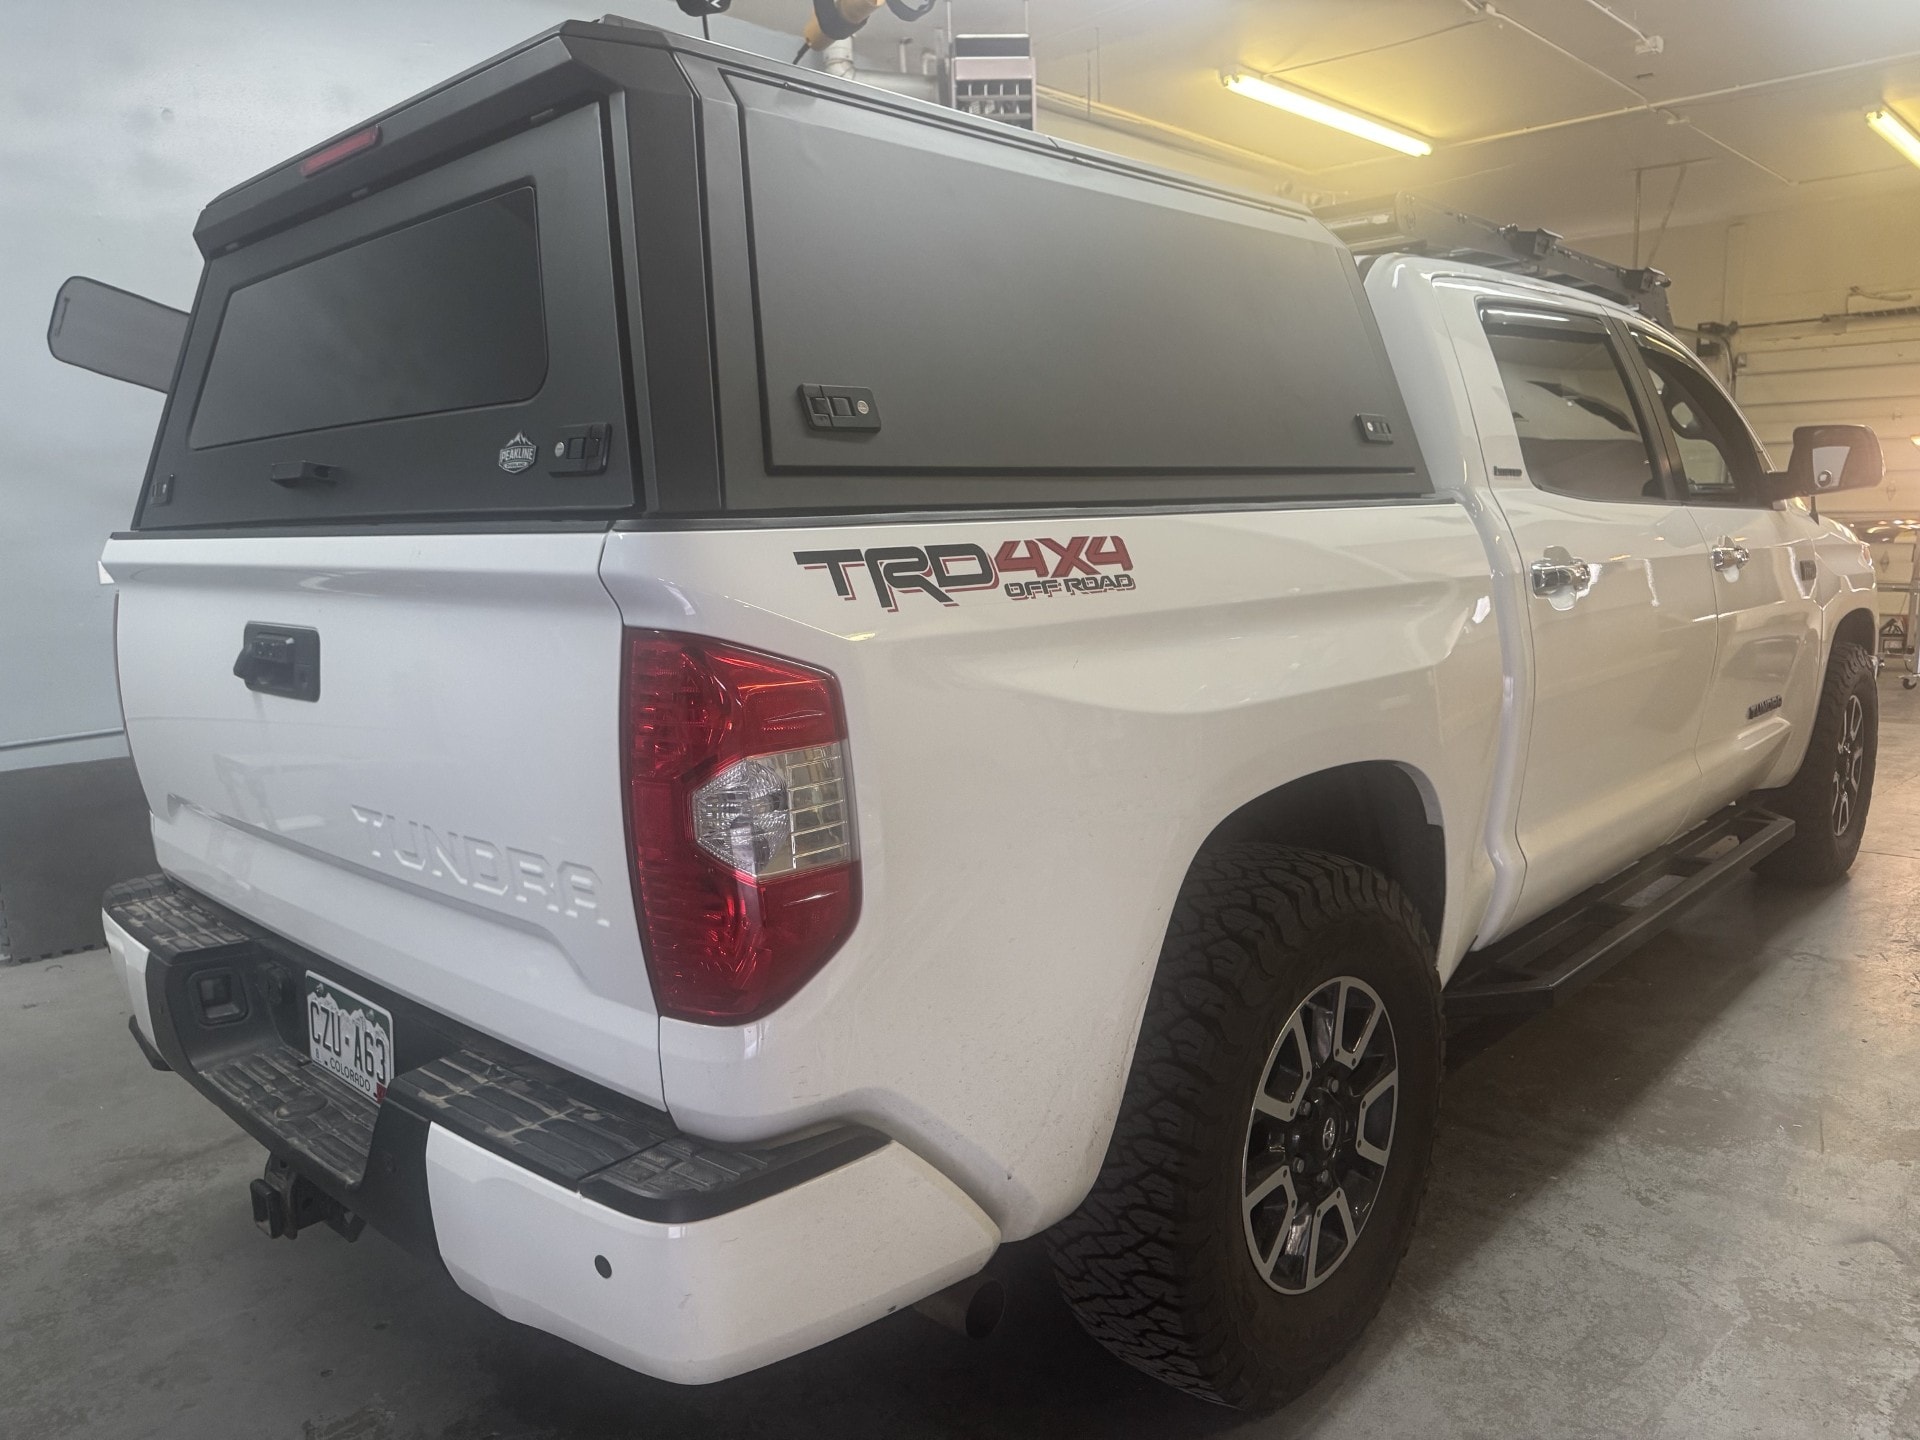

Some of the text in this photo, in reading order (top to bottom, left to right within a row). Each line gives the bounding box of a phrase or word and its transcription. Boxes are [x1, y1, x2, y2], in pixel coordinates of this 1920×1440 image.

[501, 448, 534, 461] PEAKLINE
[793, 536, 1134, 612] TRD 4X4
[1005, 574, 1136, 600] OFF ROAD
[352, 804, 610, 927] TUNDRA
[330, 1058, 371, 1092] COLORADO
